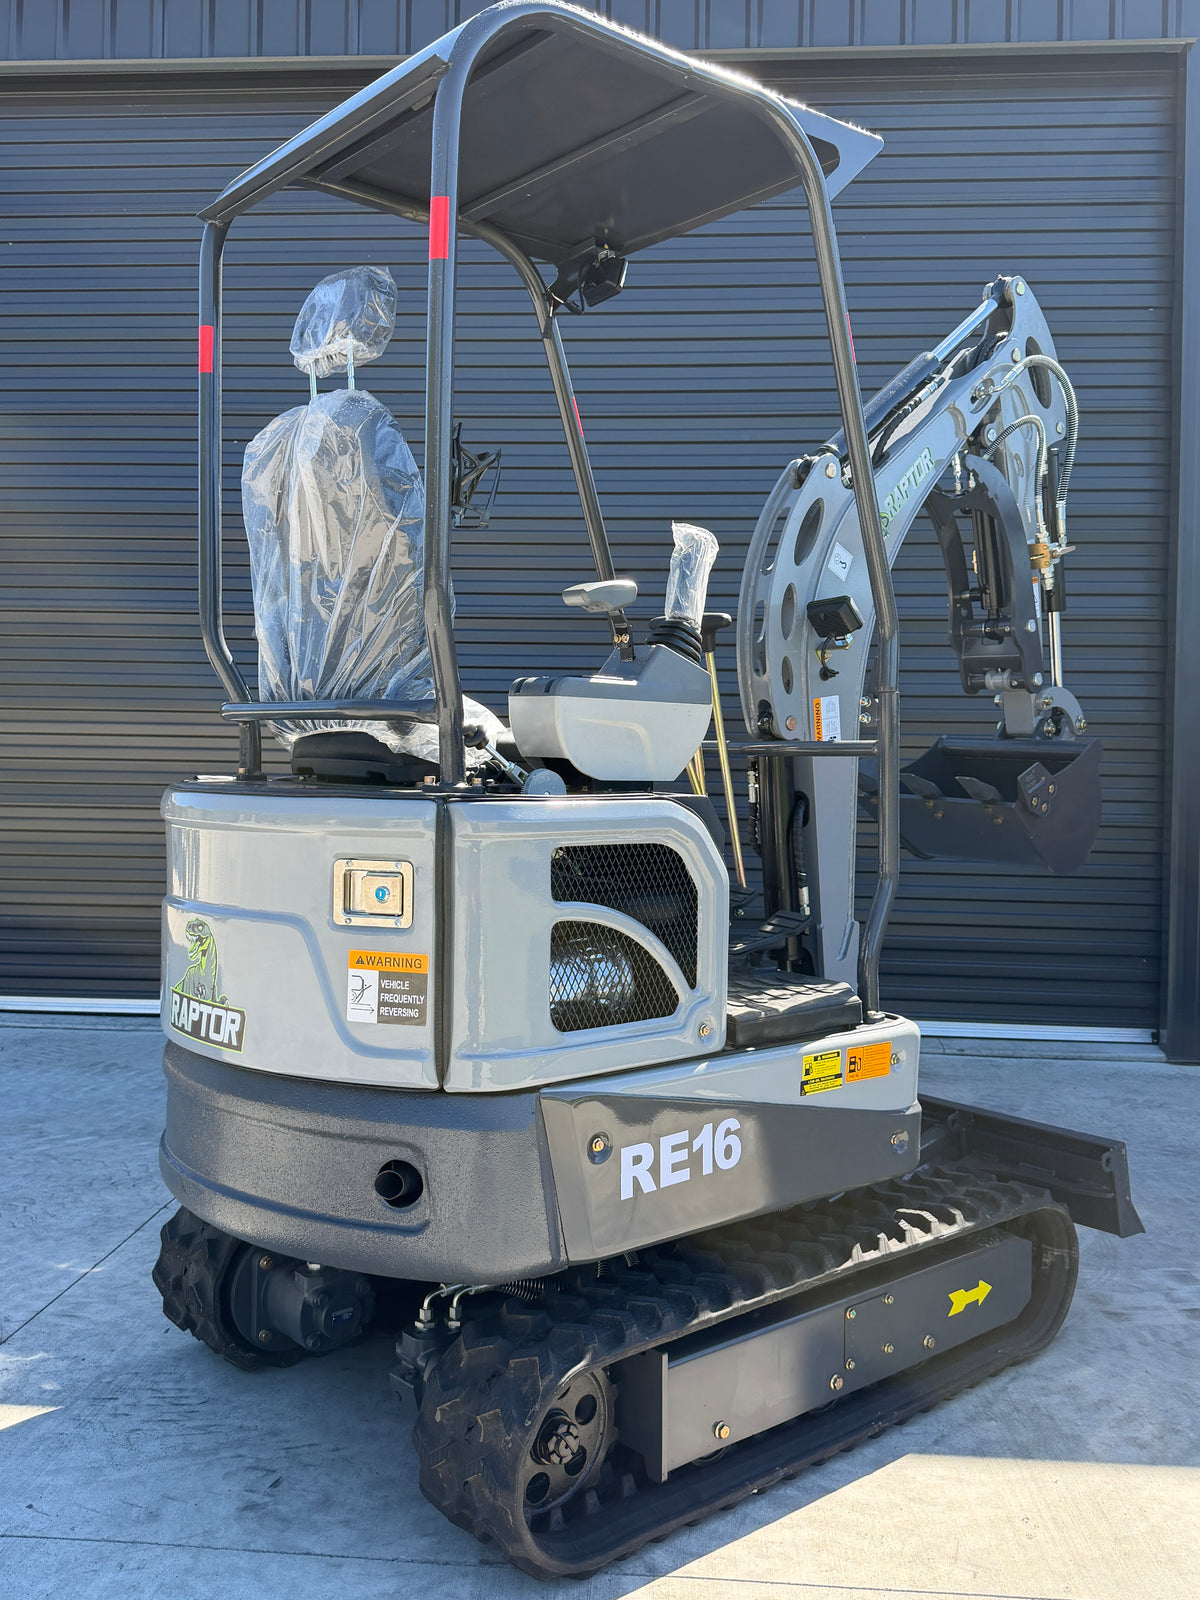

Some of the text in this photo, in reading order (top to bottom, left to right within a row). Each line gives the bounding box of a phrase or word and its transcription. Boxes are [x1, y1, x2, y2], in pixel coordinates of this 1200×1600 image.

[884, 447, 935, 521] RAPTOR
[365, 955, 422, 969] WARNING
[380, 979, 410, 990] VEHICLE
[380, 993, 425, 1005] FREQUENTLY
[171, 992, 241, 1046] RAPTOR
[379, 1006, 419, 1018] REVERSING
[620, 1117, 742, 1201] RE16
